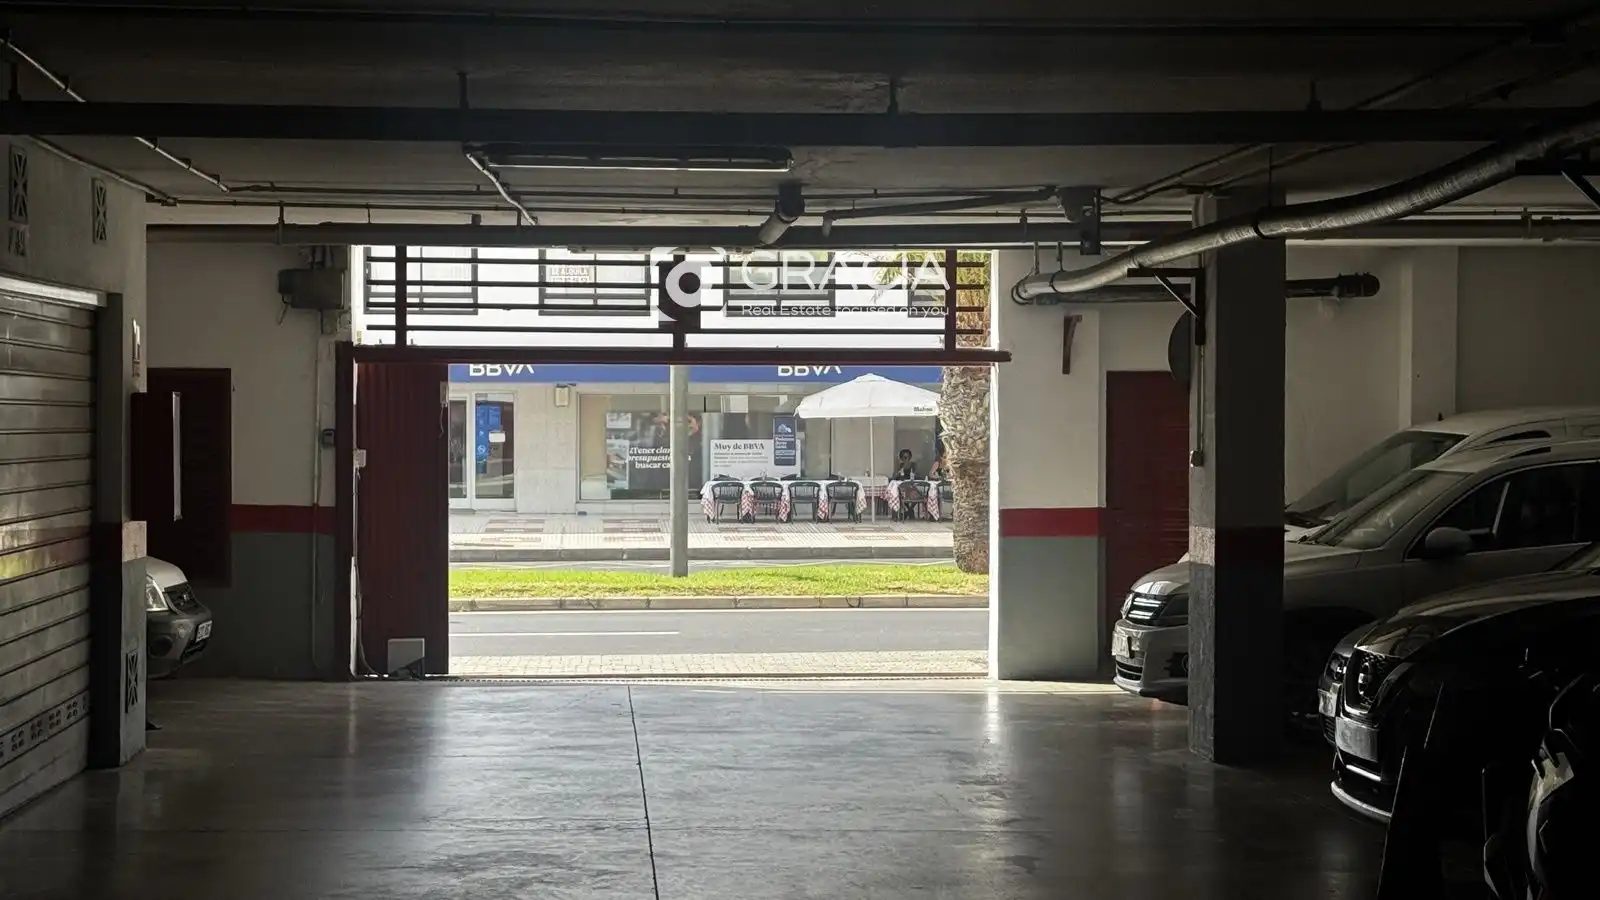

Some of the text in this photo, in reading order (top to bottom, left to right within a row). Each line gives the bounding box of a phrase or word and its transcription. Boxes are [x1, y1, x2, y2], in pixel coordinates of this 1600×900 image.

[469, 364, 535, 377] BBVA
[714, 443, 732, 452] Muy
[635, 461, 661, 469] buscar
